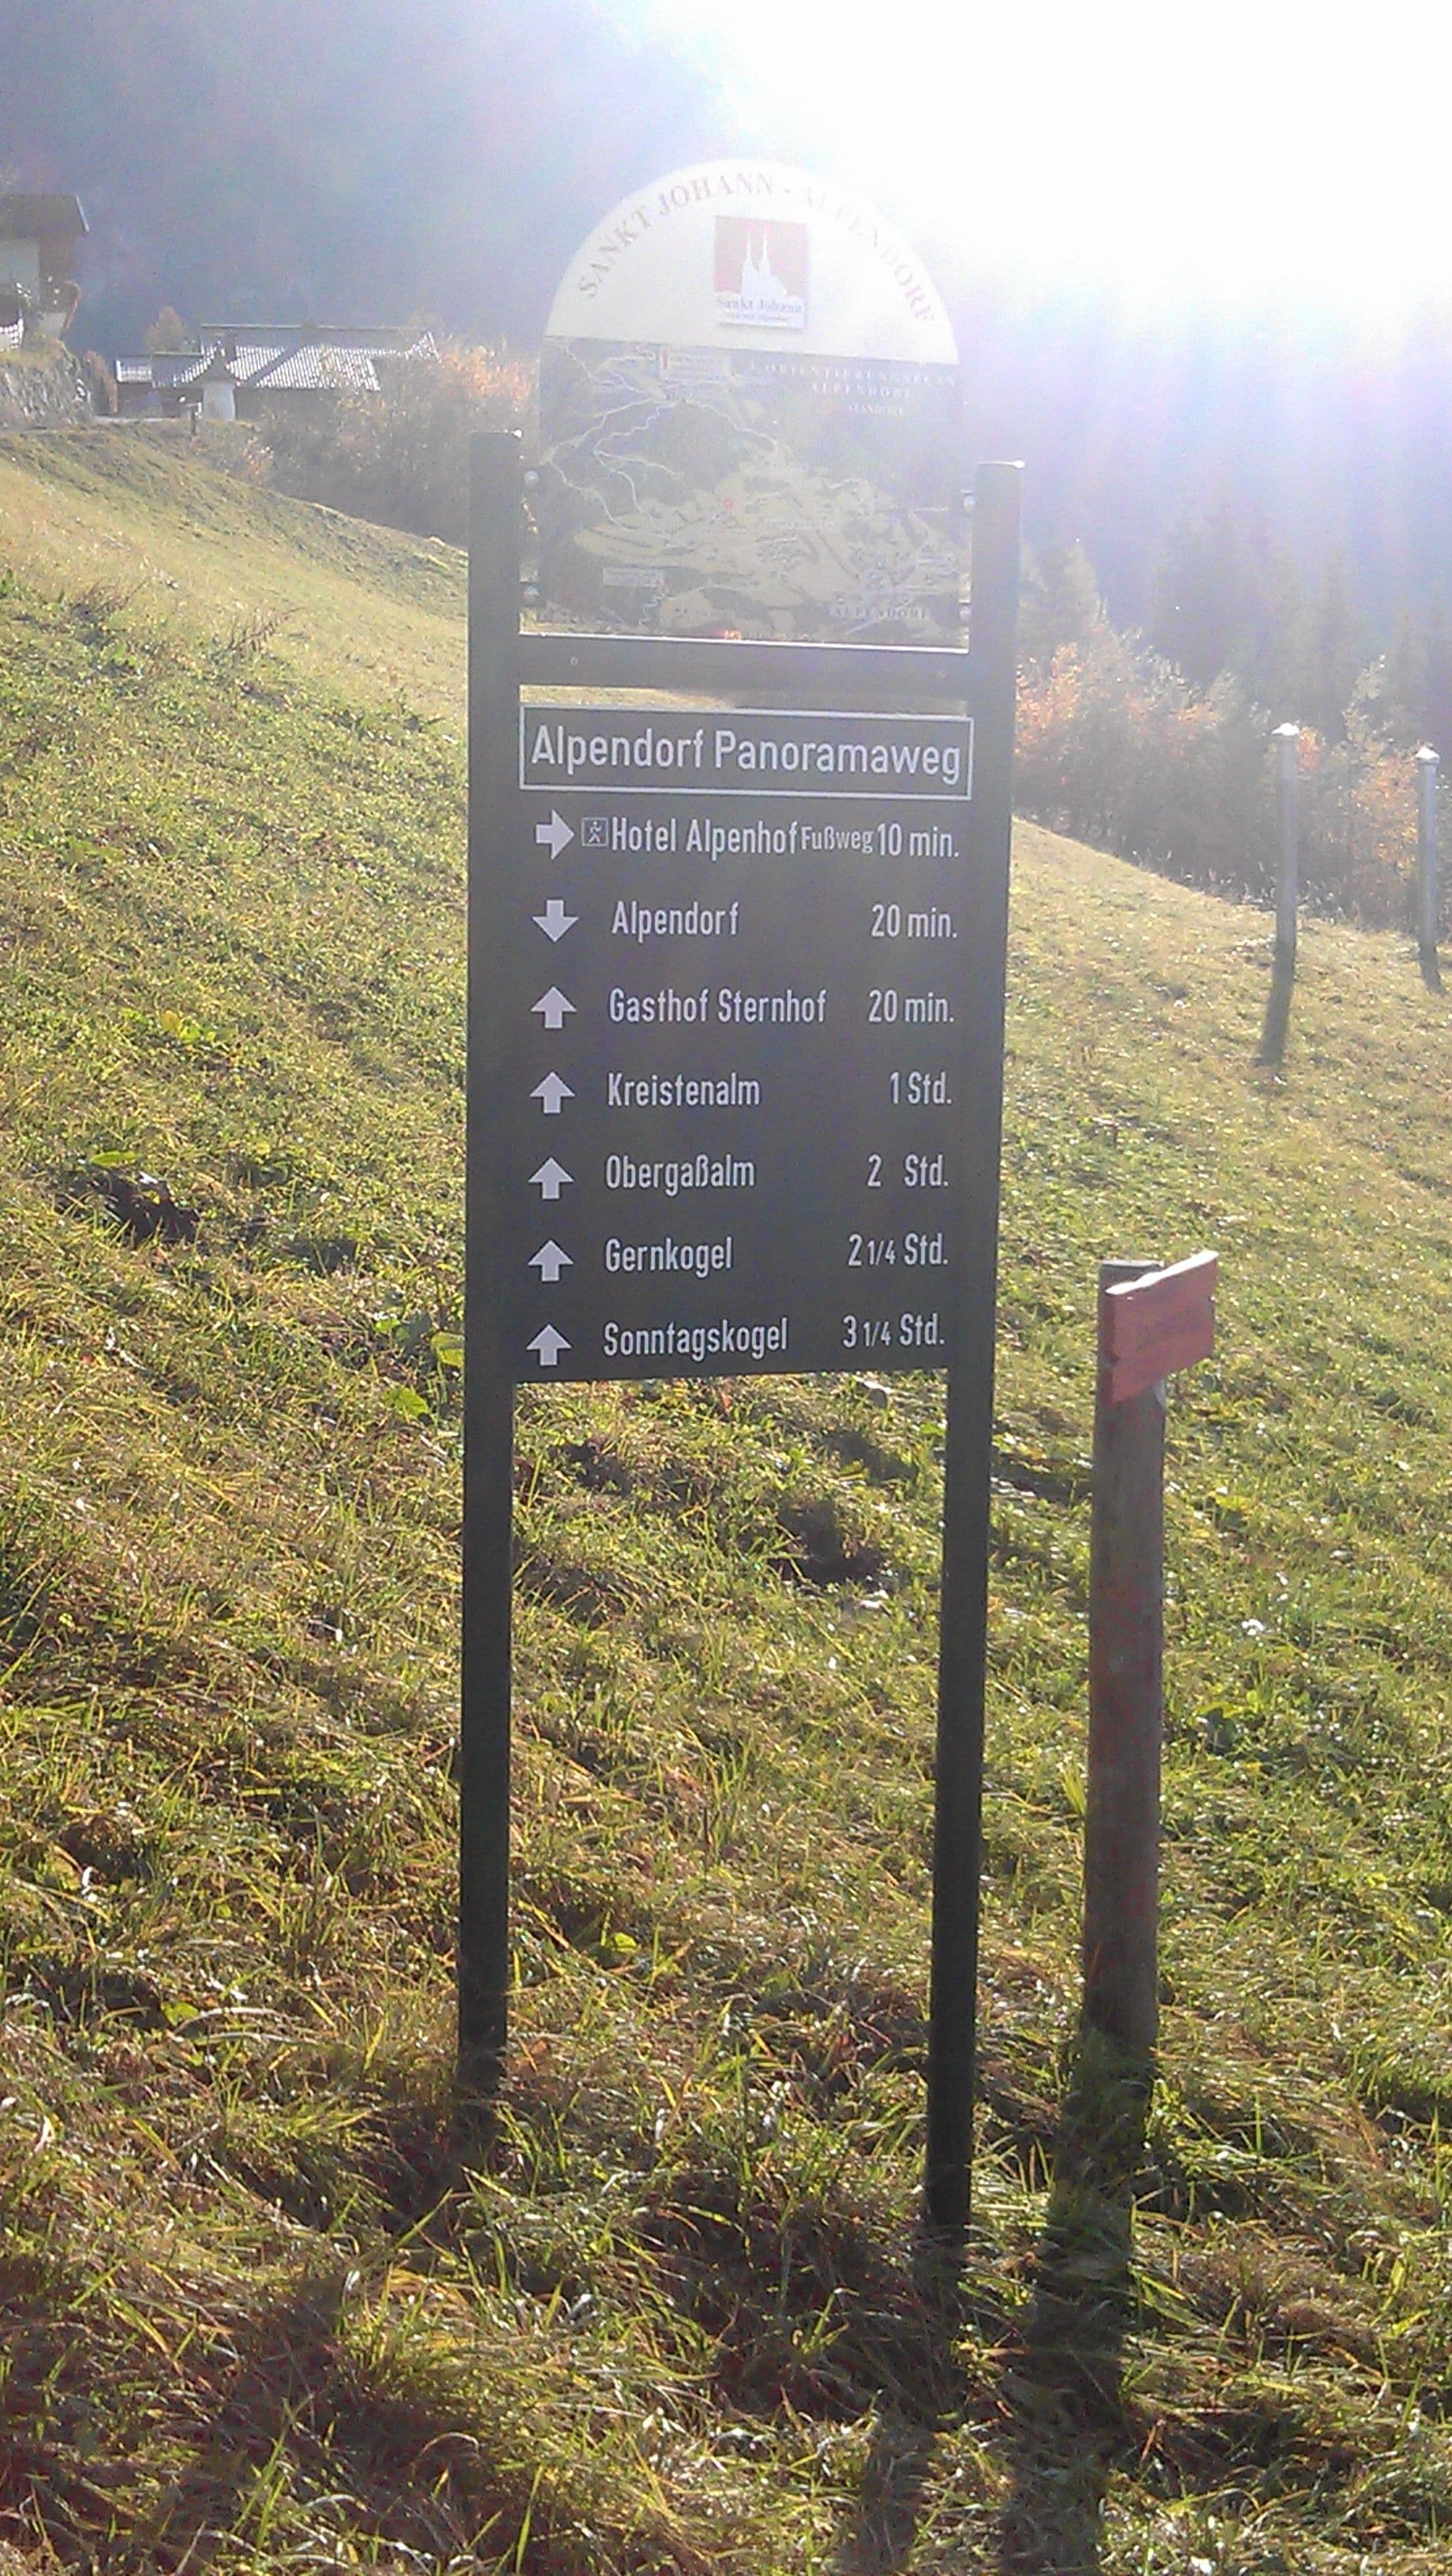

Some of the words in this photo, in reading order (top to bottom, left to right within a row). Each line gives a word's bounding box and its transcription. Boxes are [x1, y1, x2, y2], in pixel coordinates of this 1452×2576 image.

[578, 204, 654, 298] SANKT
[658, 171, 774, 216] JOHANN
[717, 296, 753, 310] Sankt
[758, 298, 803, 313] Johann
[531, 724, 704, 775] Alpendorf
[715, 730, 960, 785] Panoramaweg
[612, 816, 676, 852] Hotel
[686, 818, 798, 862] Alpenhof
[801, 826, 874, 854] Fußweg
[877, 823, 902, 856] 10
[909, 826, 960, 857] min.
[611, 900, 739, 944] Alpendorf
[871, 904, 900, 938] 20
[908, 907, 957, 938] min.
[609, 987, 709, 1022] Gasthof
[717, 988, 827, 1023] Sternhof
[868, 989, 897, 1022] 20
[904, 991, 955, 1023] min.
[608, 1072, 760, 1106] Kreistenalm
[890, 1071, 900, 1104] 1
[908, 1071, 952, 1105] Std.
[606, 1154, 754, 1197] Obergaßalm
[904, 1154, 949, 1187] Std.
[605, 1236, 732, 1279] Gernkogel
[904, 1232, 949, 1265] Std.
[603, 1316, 788, 1362] Sonntagskogel
[899, 1312, 945, 1346] Std.
